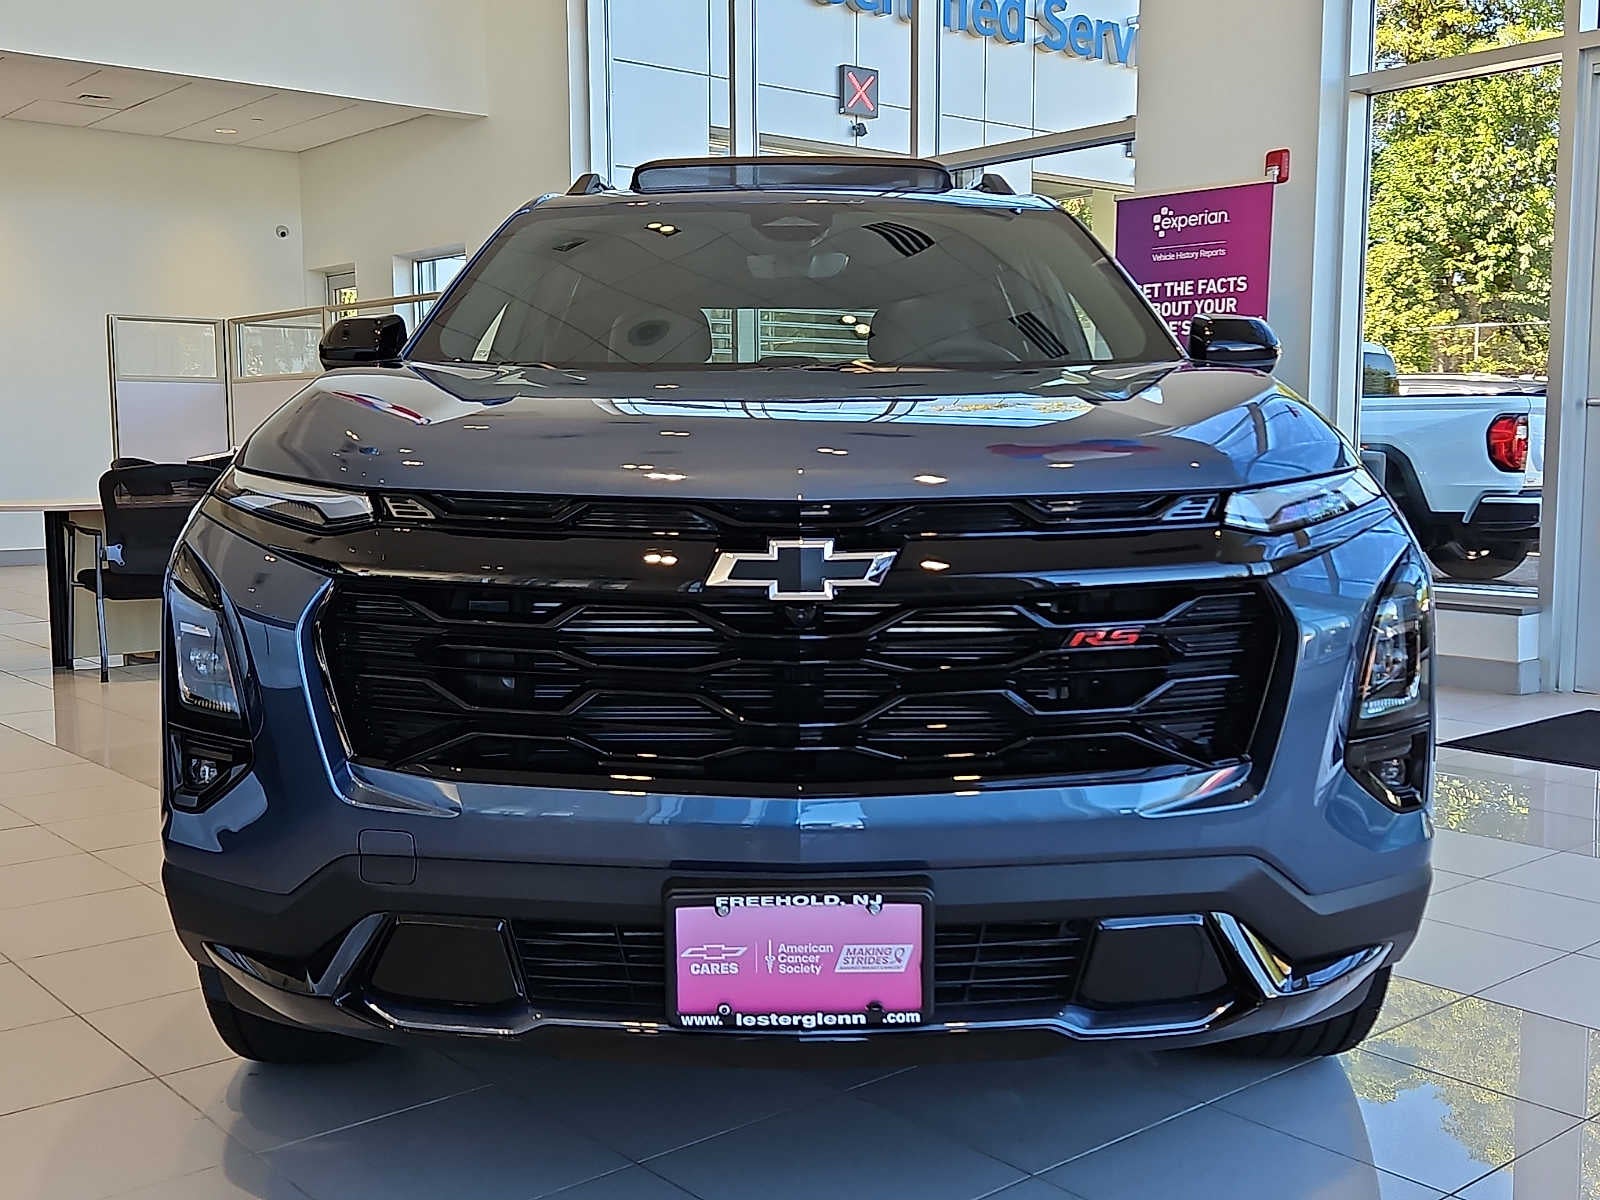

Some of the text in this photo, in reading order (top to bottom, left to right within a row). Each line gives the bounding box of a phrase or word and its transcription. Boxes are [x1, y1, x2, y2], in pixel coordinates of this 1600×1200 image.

[1034, 0, 1138, 63] Serv
[1152, 249, 1226, 262] Vehicle History Reports
[1164, 280, 1194, 297] THE
[1197, 276, 1248, 294] FACTS
[1152, 297, 1237, 317] BOUT YOUR
[1069, 629, 1141, 647] RS
[853, 895, 883, 906] NJ
[778, 944, 833, 953] American
[846, 947, 892, 956] MAKING
[778, 954, 820, 963] Cancer
[843, 956, 889, 965] STRIDES
[690, 963, 739, 975] CARES
[779, 963, 822, 975] Society
[736, 1013, 866, 1028] lesterglenn
